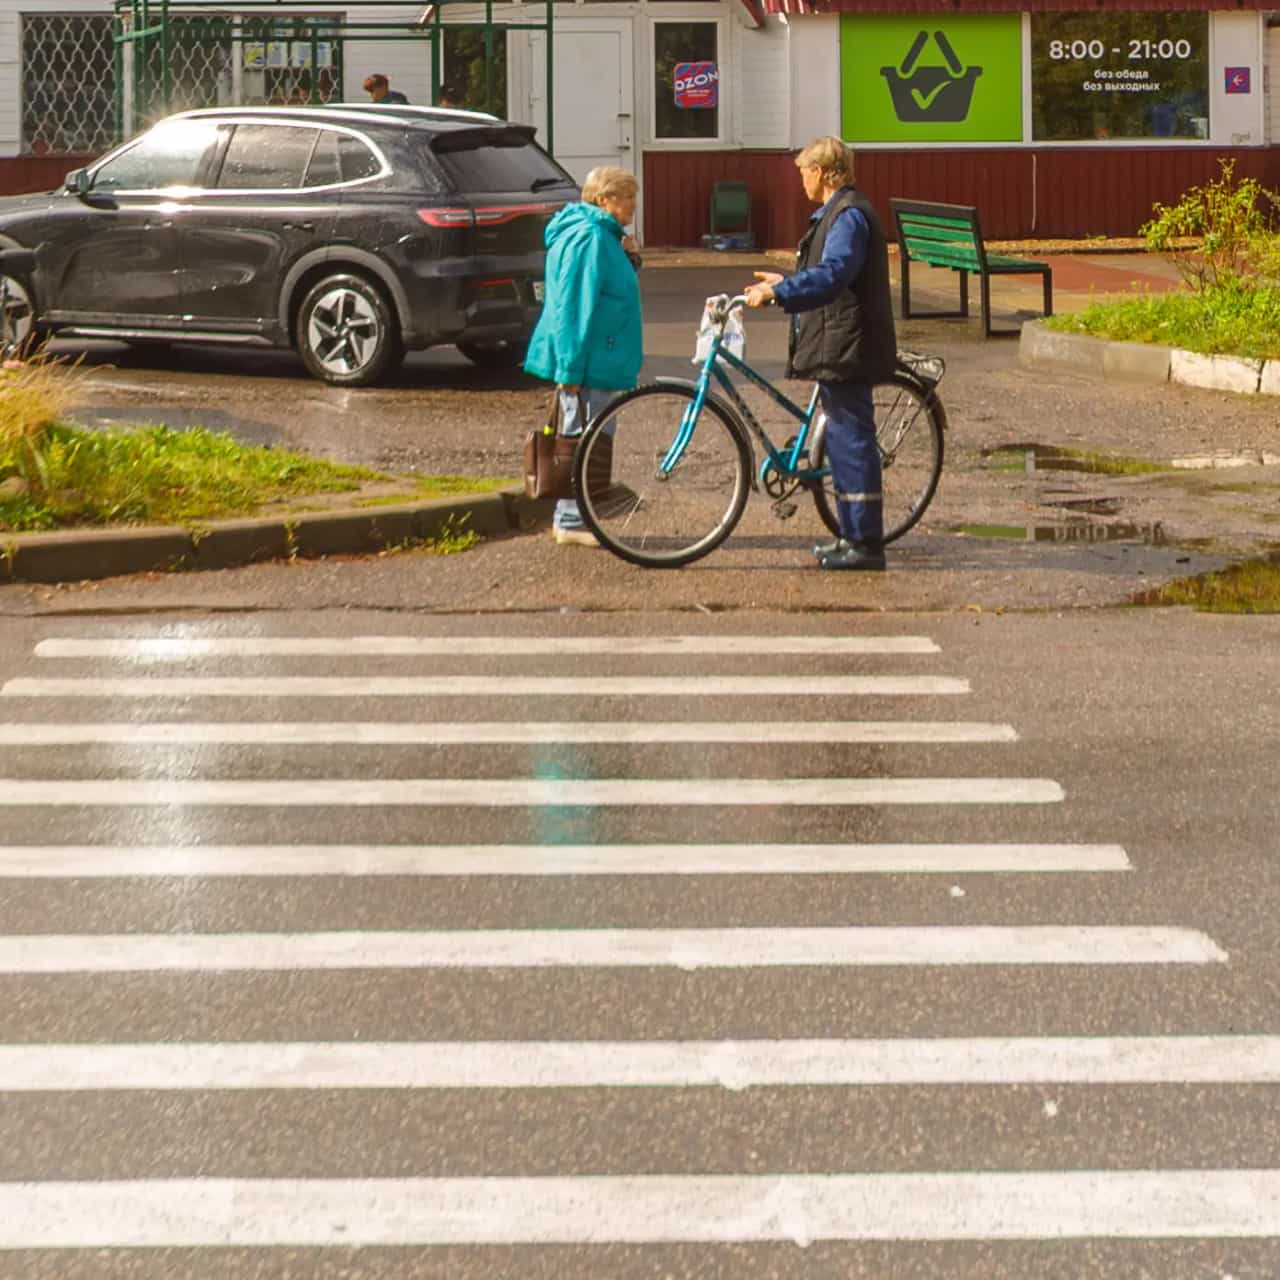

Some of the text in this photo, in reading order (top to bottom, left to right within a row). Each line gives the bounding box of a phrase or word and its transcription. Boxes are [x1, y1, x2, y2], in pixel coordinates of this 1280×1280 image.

[1049, 39, 1104, 59] 8:00
[1128, 39, 1191, 59] 21:00
[674, 70, 720, 91] OZON
[1094, 69, 1149, 80] без обеда
[1083, 81, 1160, 92] без выходных
